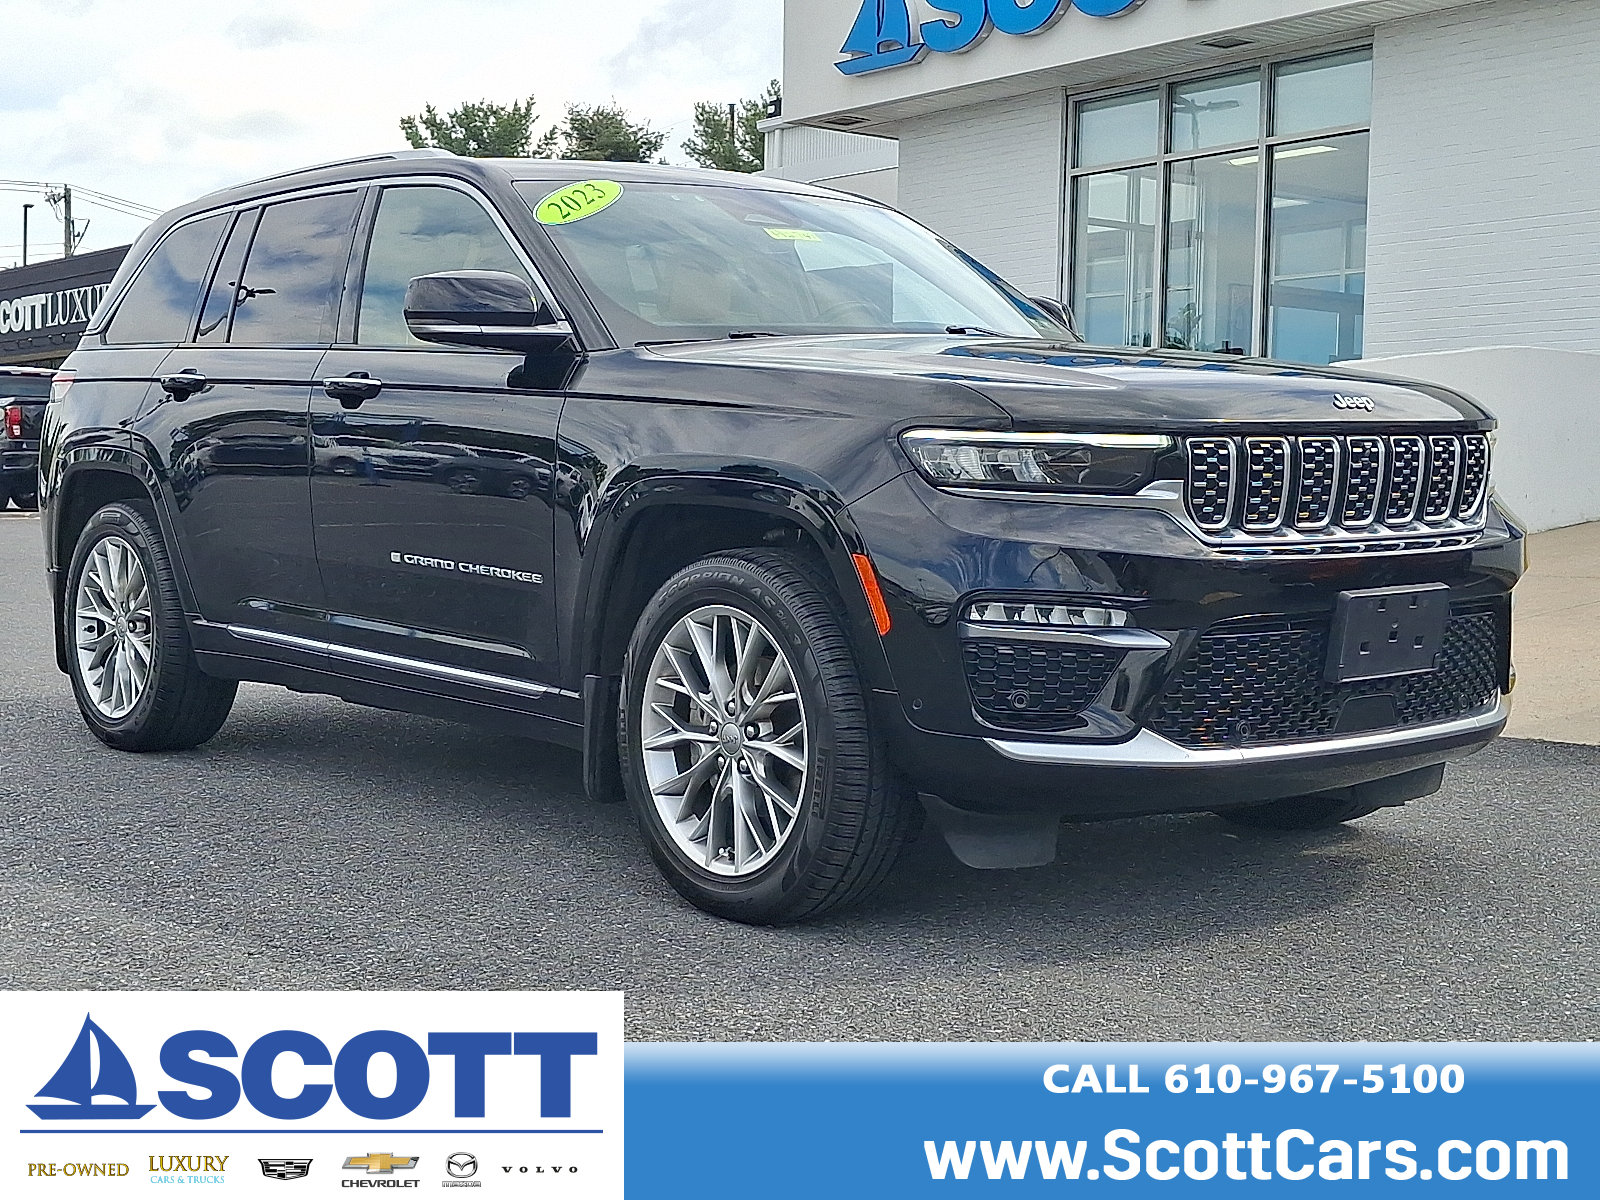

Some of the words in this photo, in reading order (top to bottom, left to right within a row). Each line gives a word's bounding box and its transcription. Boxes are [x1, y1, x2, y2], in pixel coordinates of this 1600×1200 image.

[547, 183, 606, 219] 2023
[0, 293, 46, 334] COTT
[45, 283, 111, 327] LUXU
[1333, 393, 1375, 412] Jeep
[403, 554, 455, 570] GRAND
[458, 562, 544, 584] CHEROKEE
